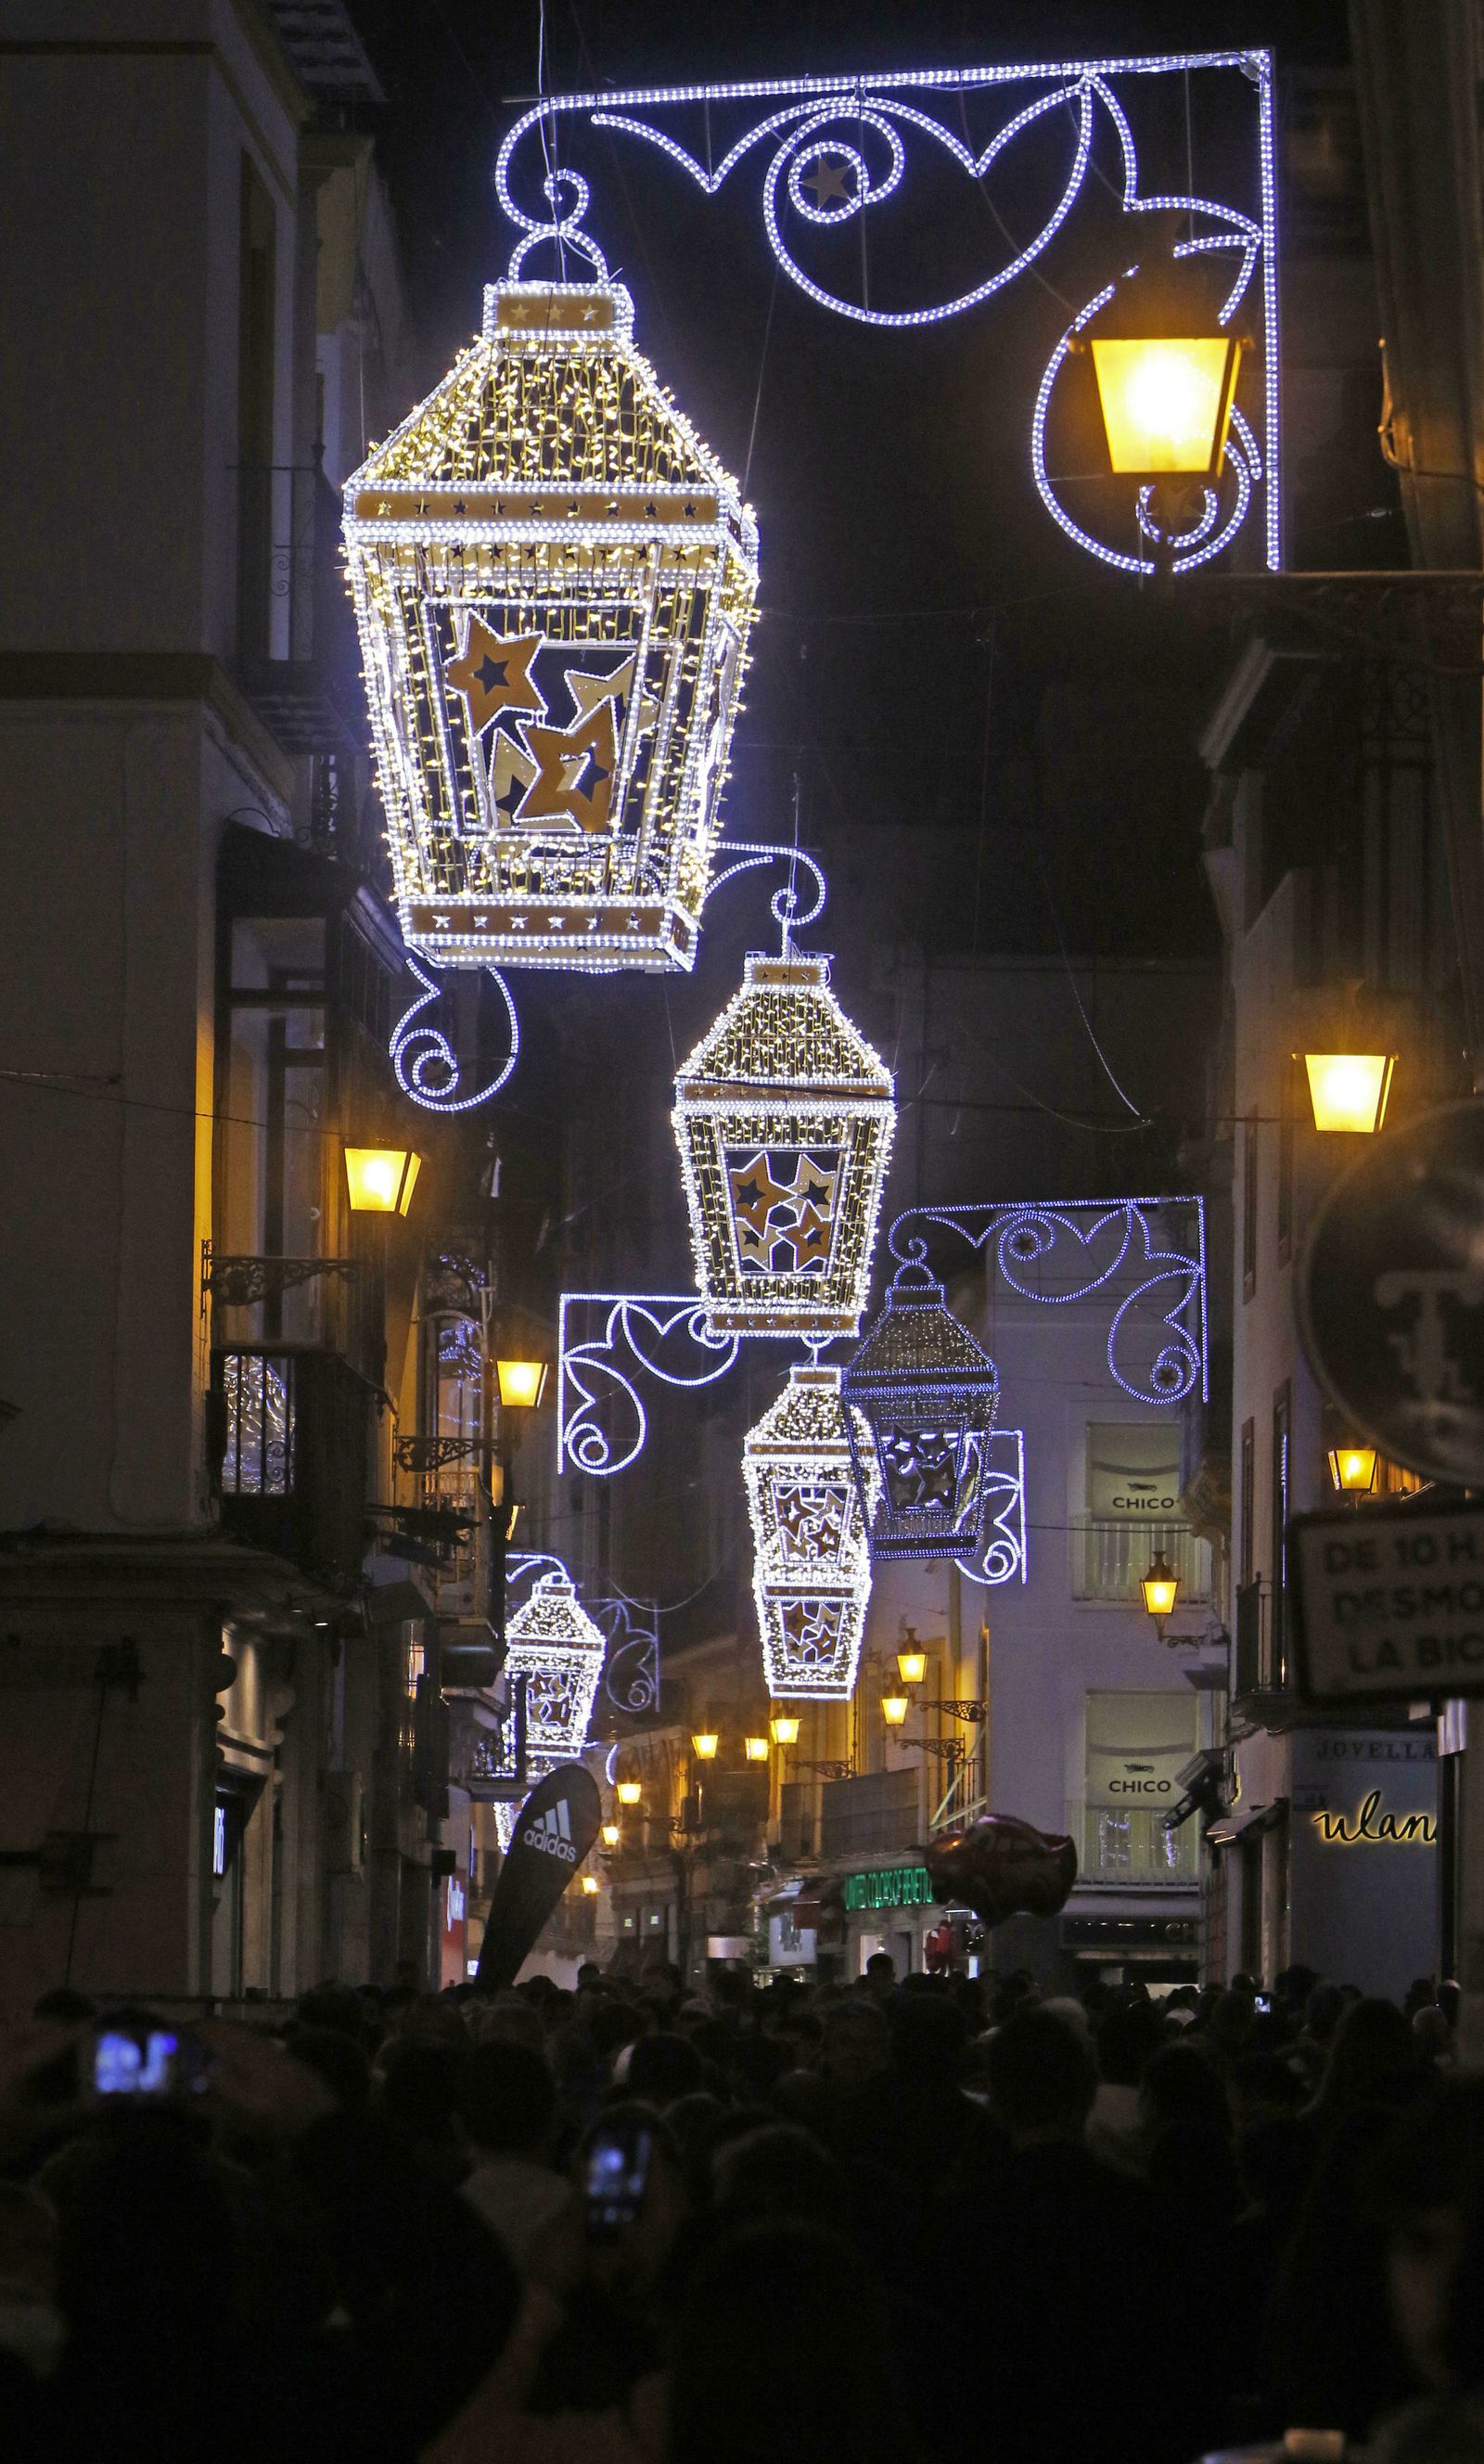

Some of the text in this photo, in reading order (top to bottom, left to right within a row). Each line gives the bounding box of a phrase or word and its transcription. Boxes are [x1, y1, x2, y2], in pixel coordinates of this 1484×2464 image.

[1112, 1496, 1175, 1510] CHICO
[1324, 1540, 1377, 1573] DE
[1350, 1638, 1402, 1674] LA
[1108, 1779, 1171, 1793] CHICO
[1312, 1790, 1438, 1842] ulan
[523, 1829, 576, 1863] adidas
